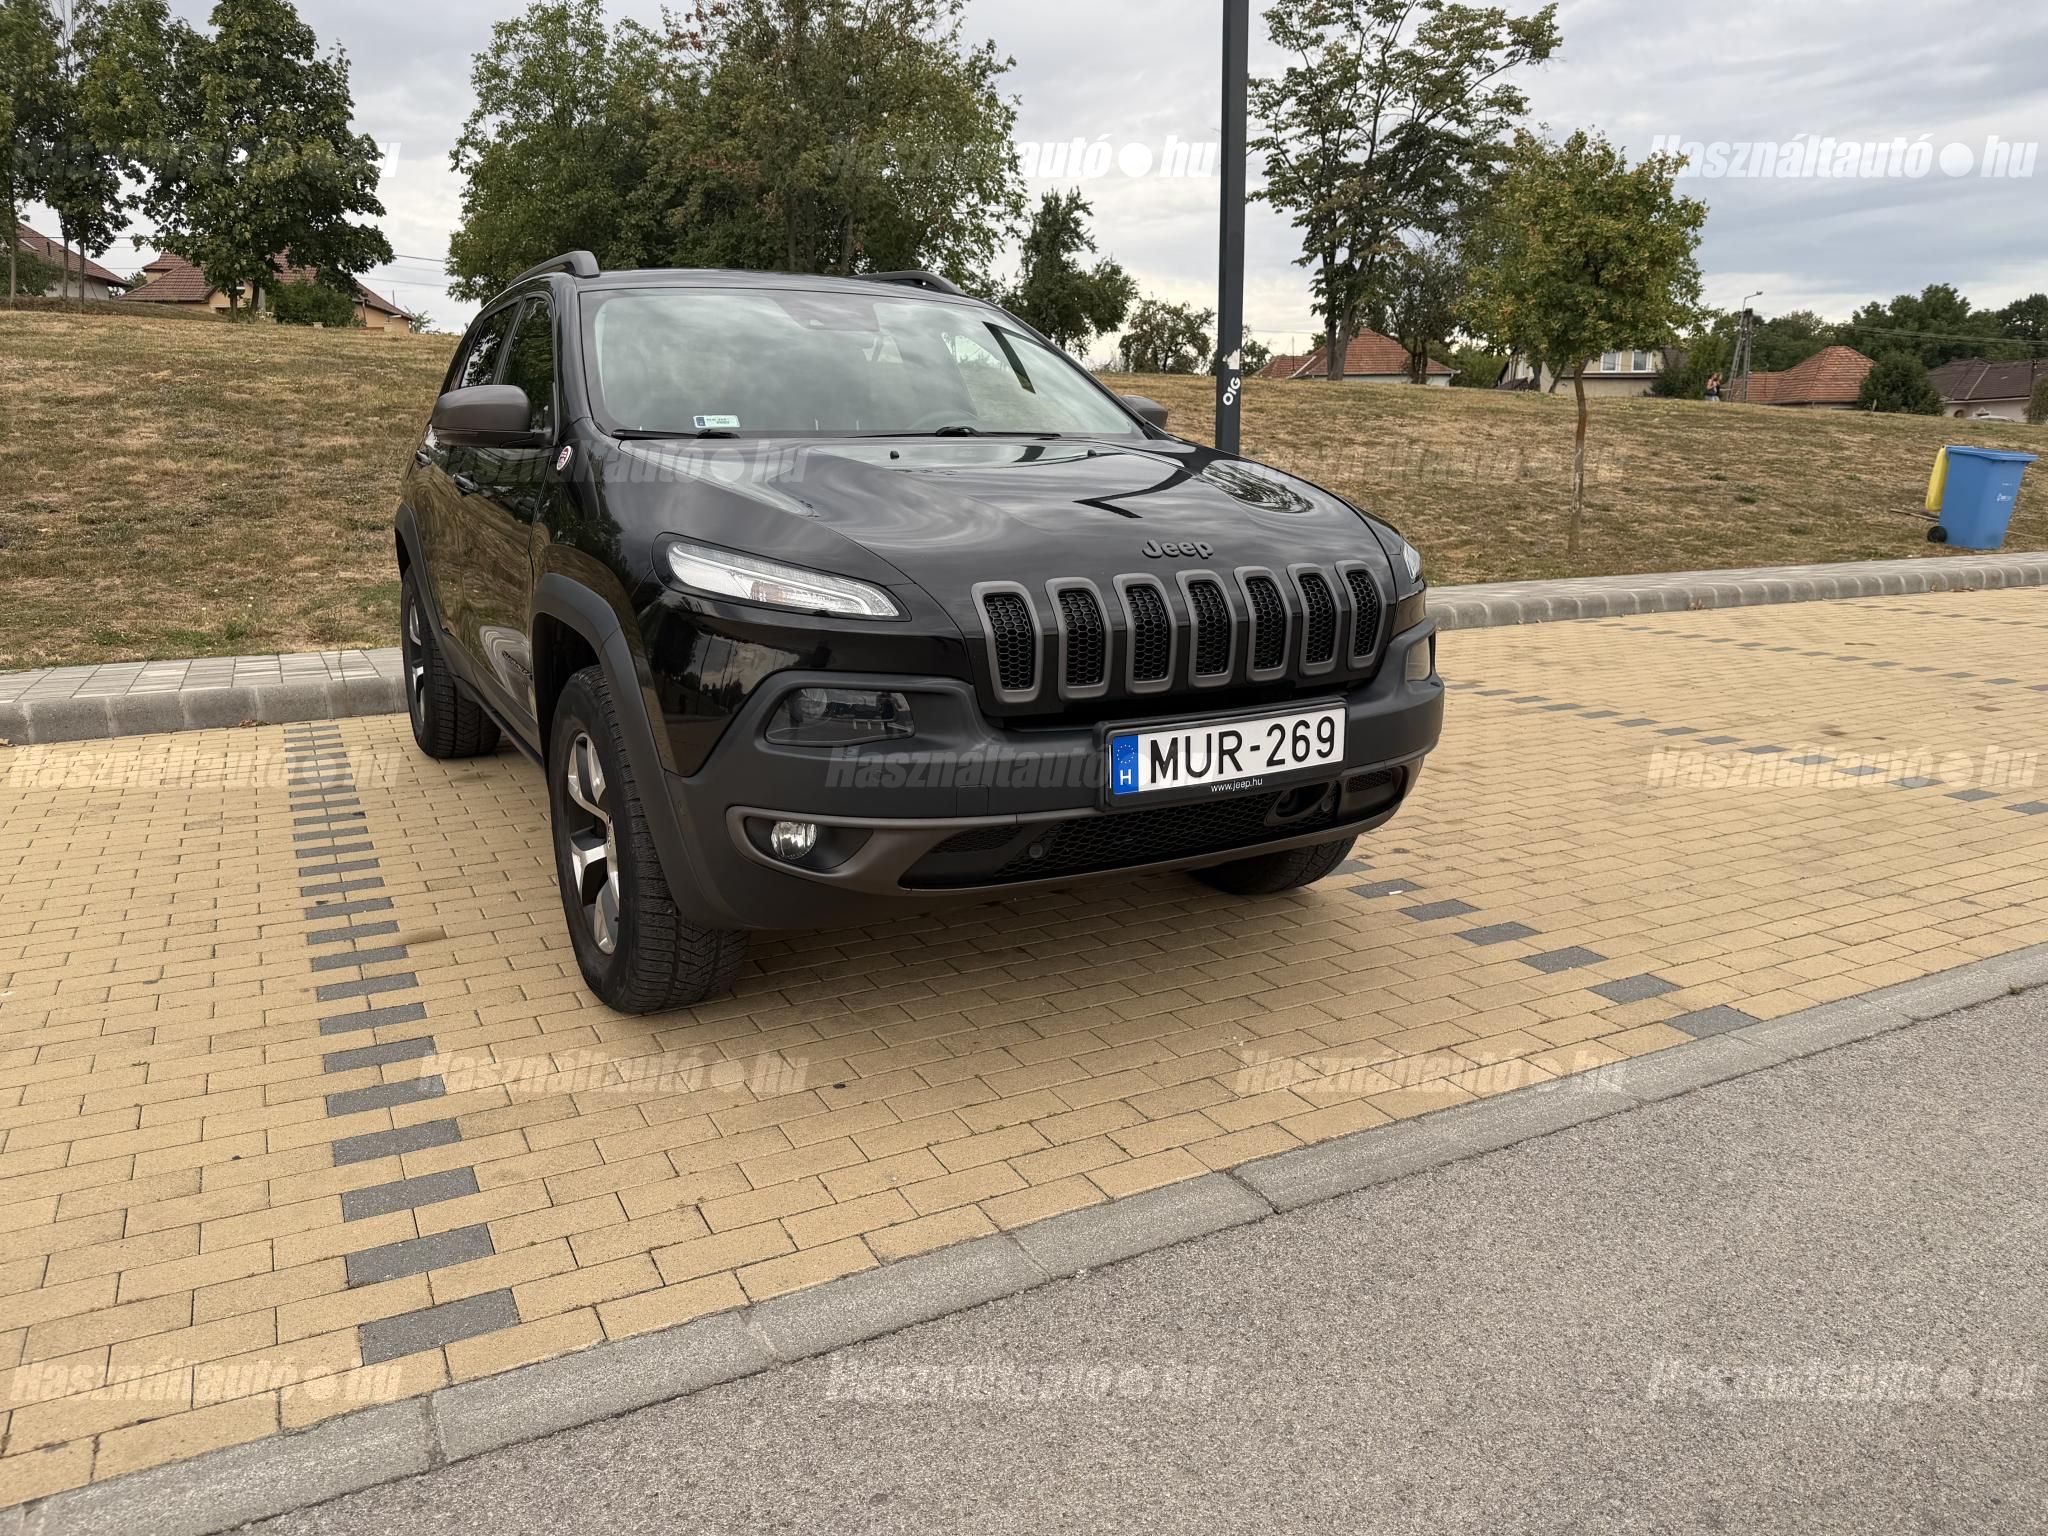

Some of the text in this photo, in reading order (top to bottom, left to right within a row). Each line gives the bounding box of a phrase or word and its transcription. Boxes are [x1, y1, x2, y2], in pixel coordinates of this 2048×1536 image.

[1142, 539, 1214, 560] Jeep
[1119, 768, 1132, 785] H
[1150, 715, 1335, 784] MUR-269
[1210, 777, 1263, 793] www.jeep.hu
